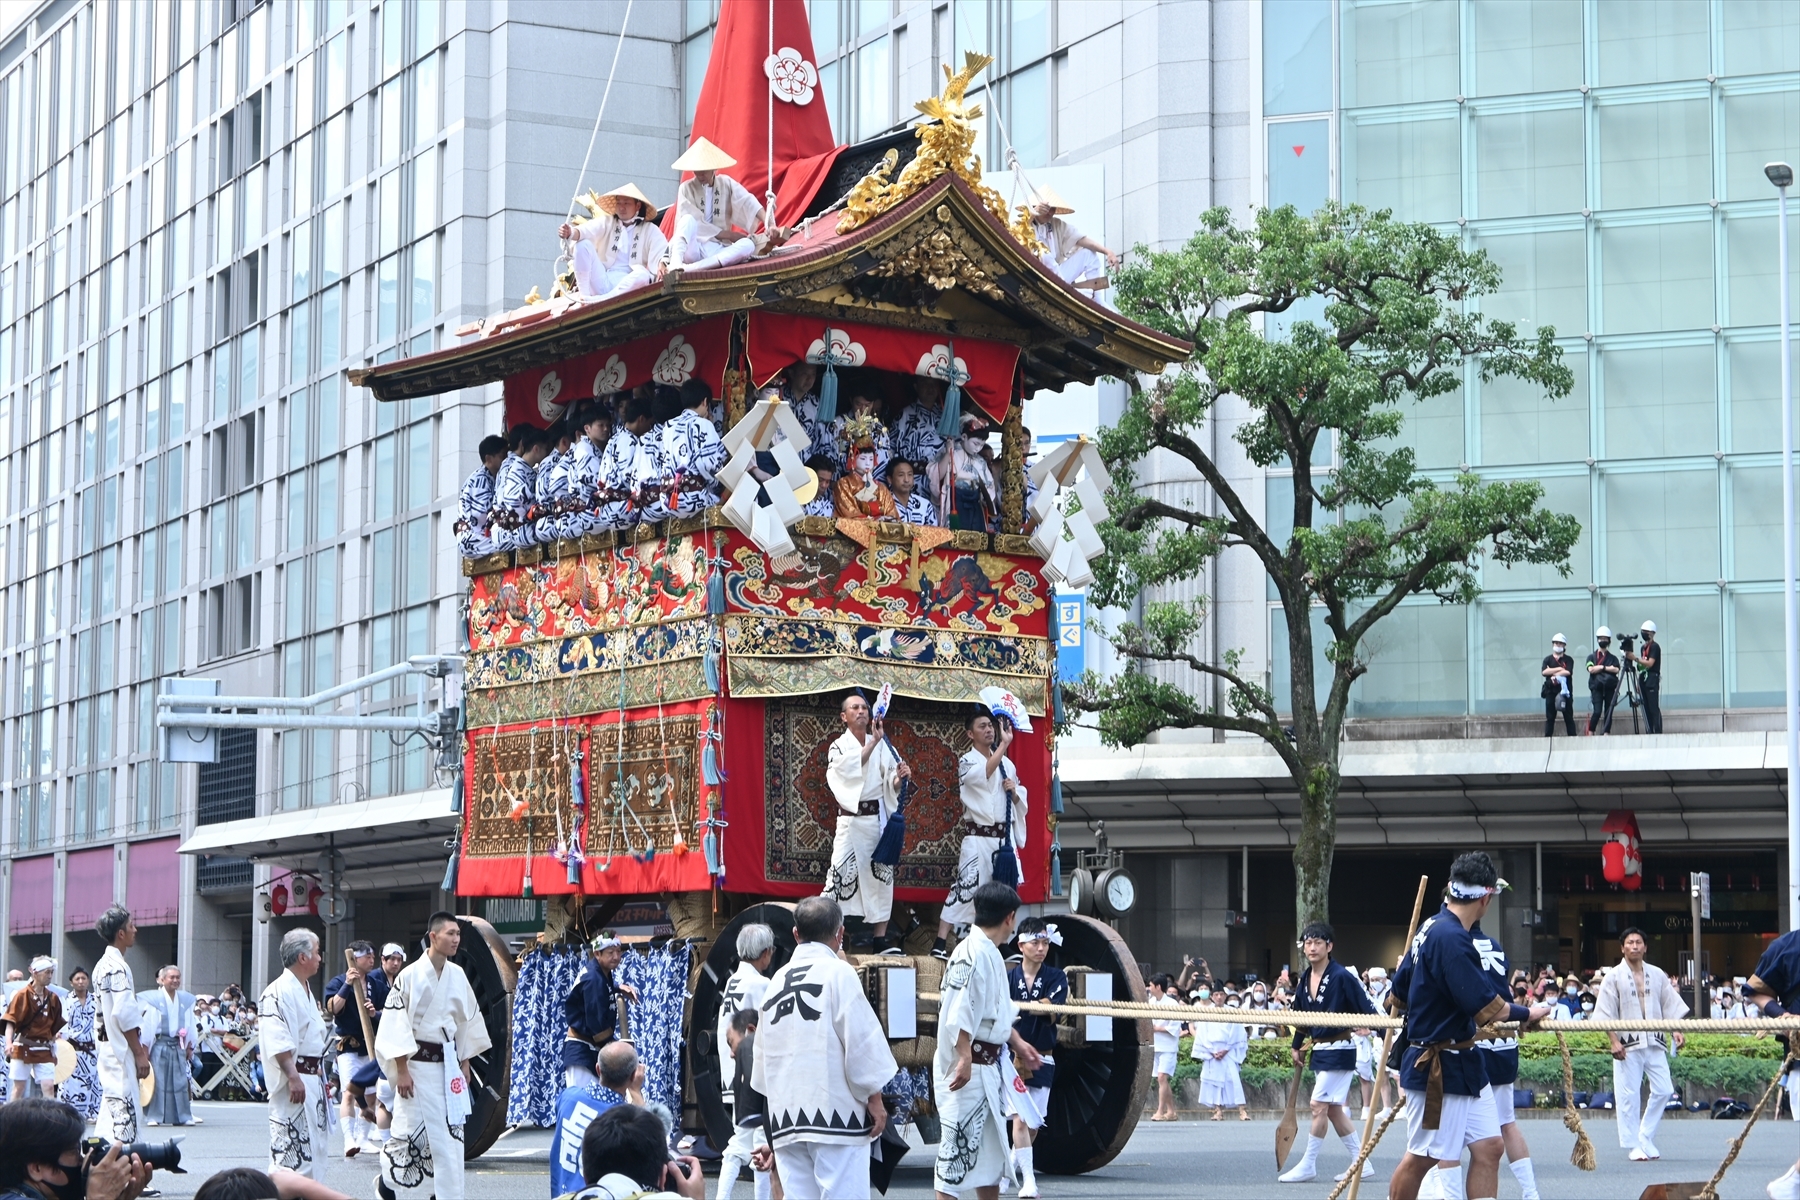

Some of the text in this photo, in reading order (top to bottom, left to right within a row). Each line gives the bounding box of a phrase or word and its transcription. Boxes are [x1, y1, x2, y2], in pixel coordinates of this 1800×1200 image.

[1062, 604, 1078, 644] すぐ
[486, 898, 536, 923] MARUMARU
[1681, 918, 1749, 930] Taashimaya
[1472, 938, 1506, 976] 長
[720, 978, 744, 1017] 長
[763, 964, 823, 1026] 長
